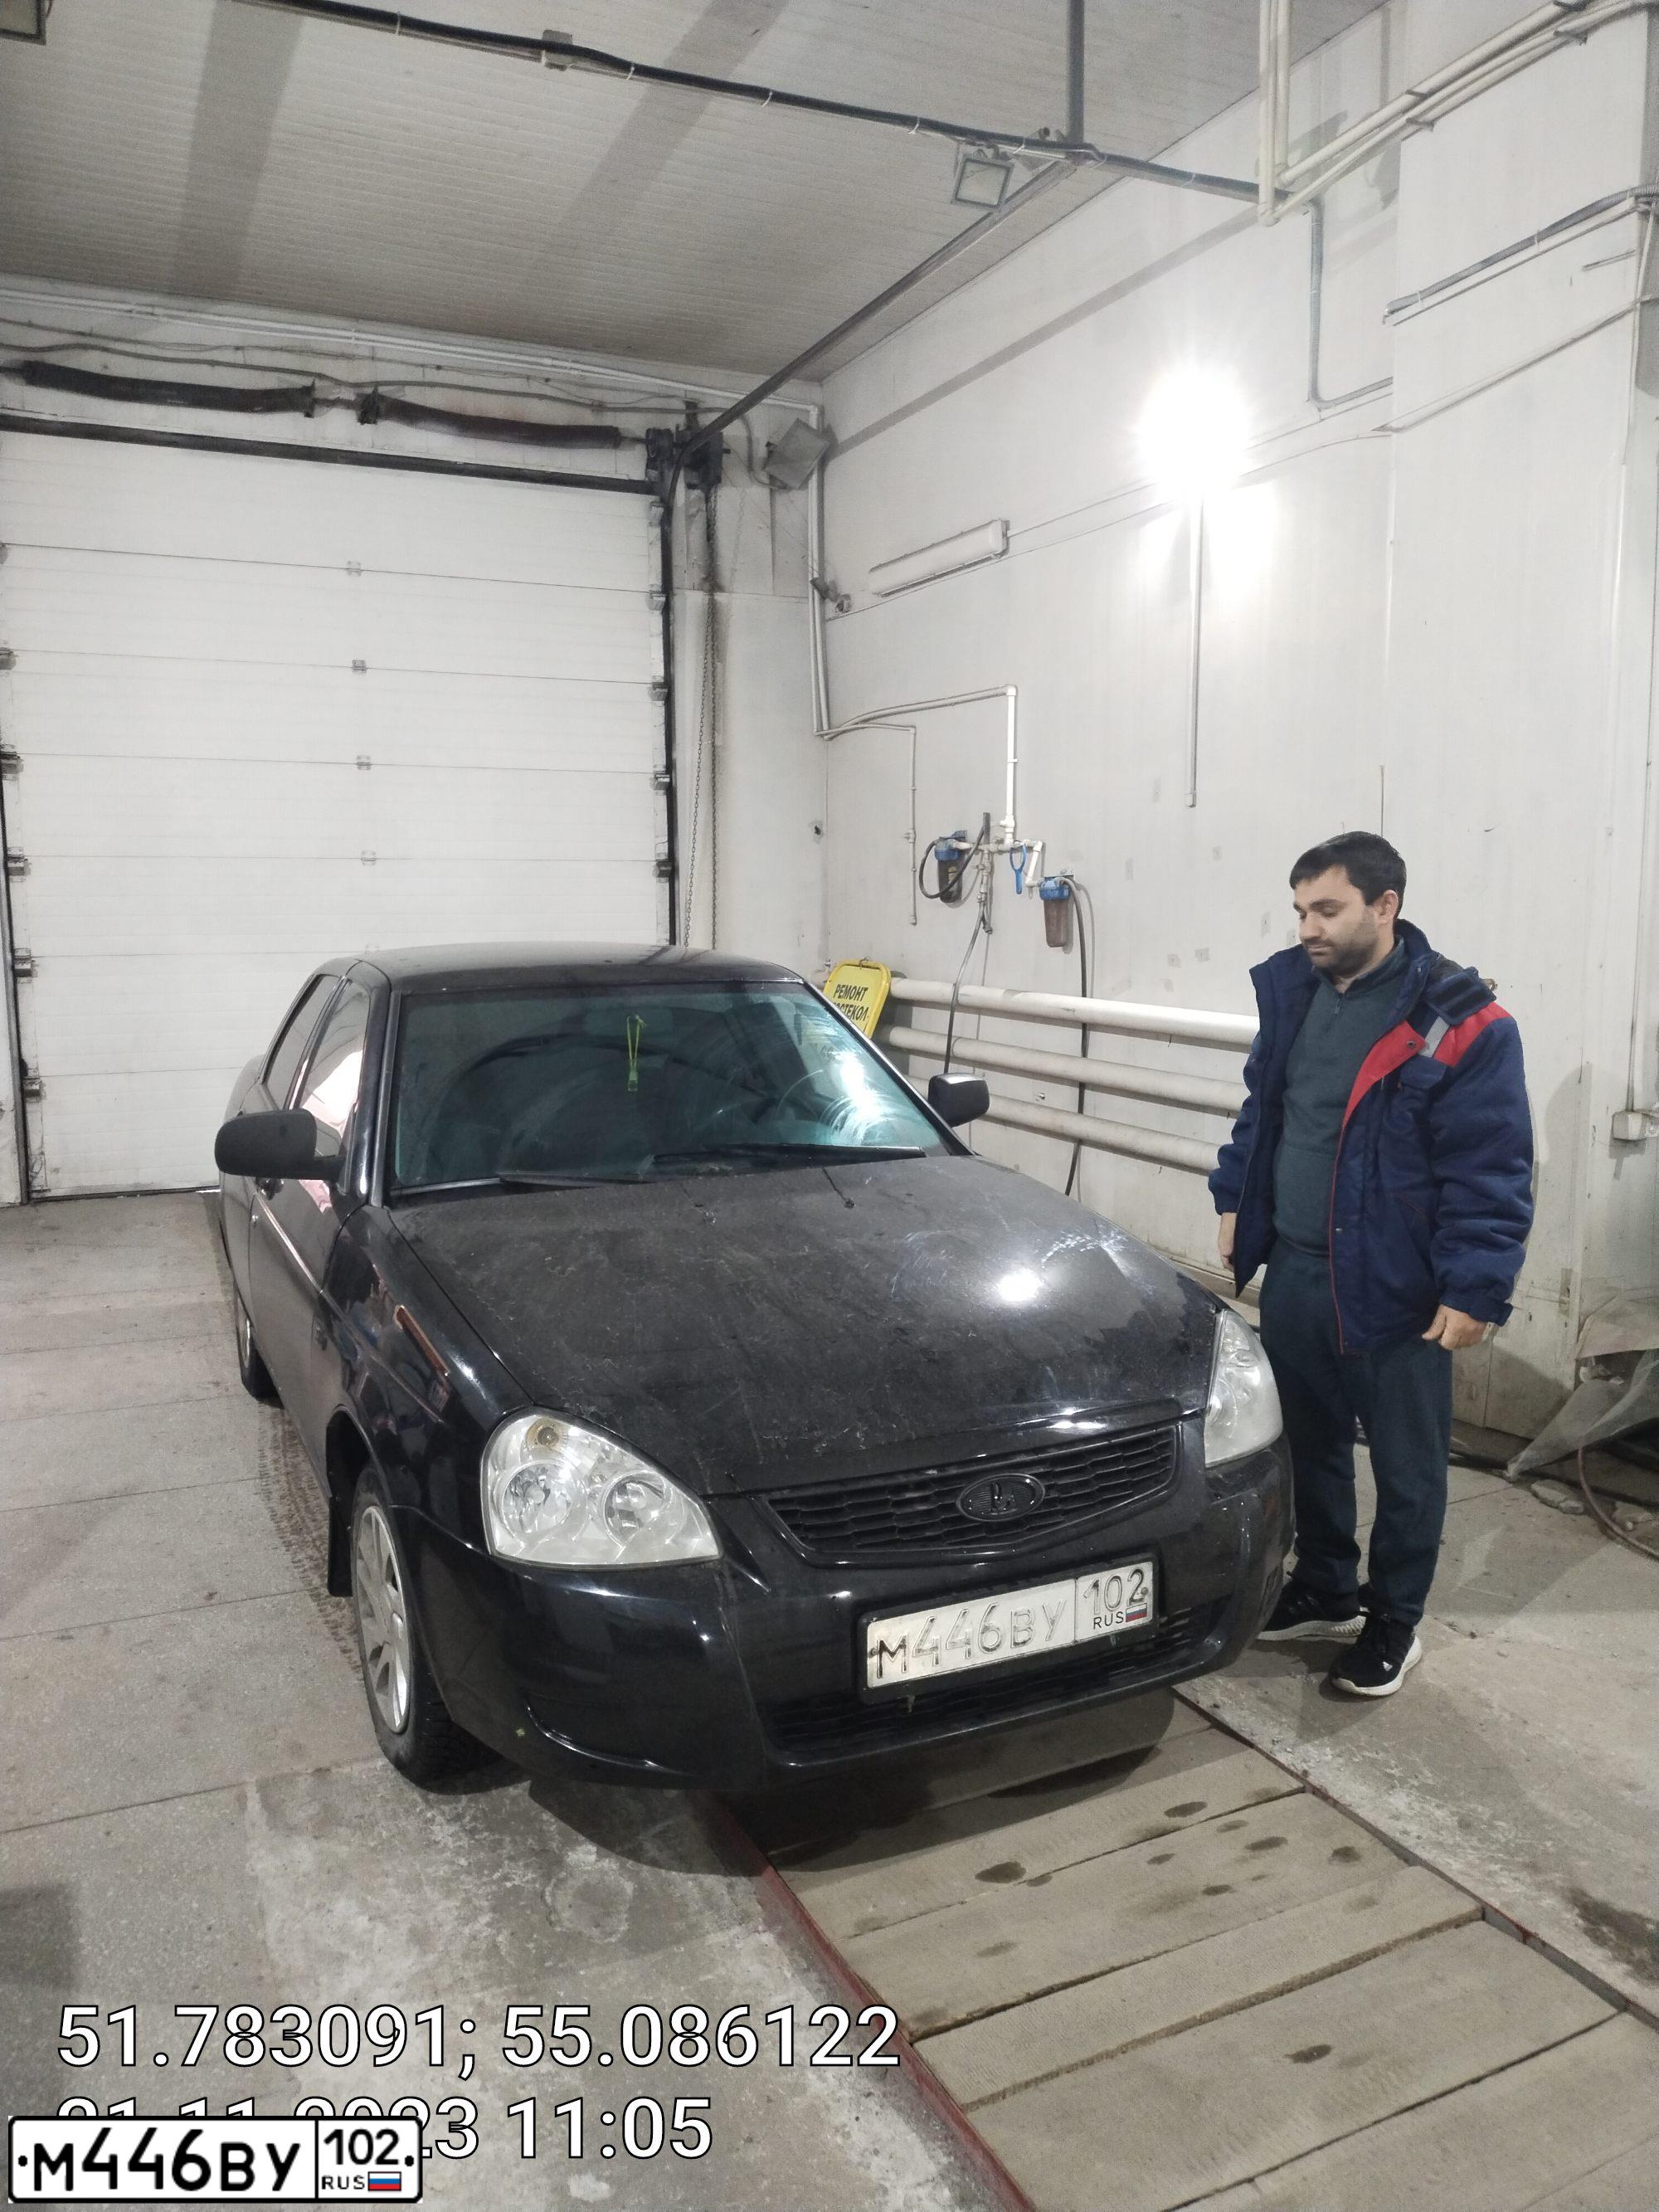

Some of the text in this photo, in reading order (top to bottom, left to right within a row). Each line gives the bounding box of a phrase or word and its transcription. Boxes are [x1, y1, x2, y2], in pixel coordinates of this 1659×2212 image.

[833, 984, 868, 1001] РЕМОНТ
[1083, 1568, 1148, 1615] 102
[1092, 1611, 1125, 1630] RUS
